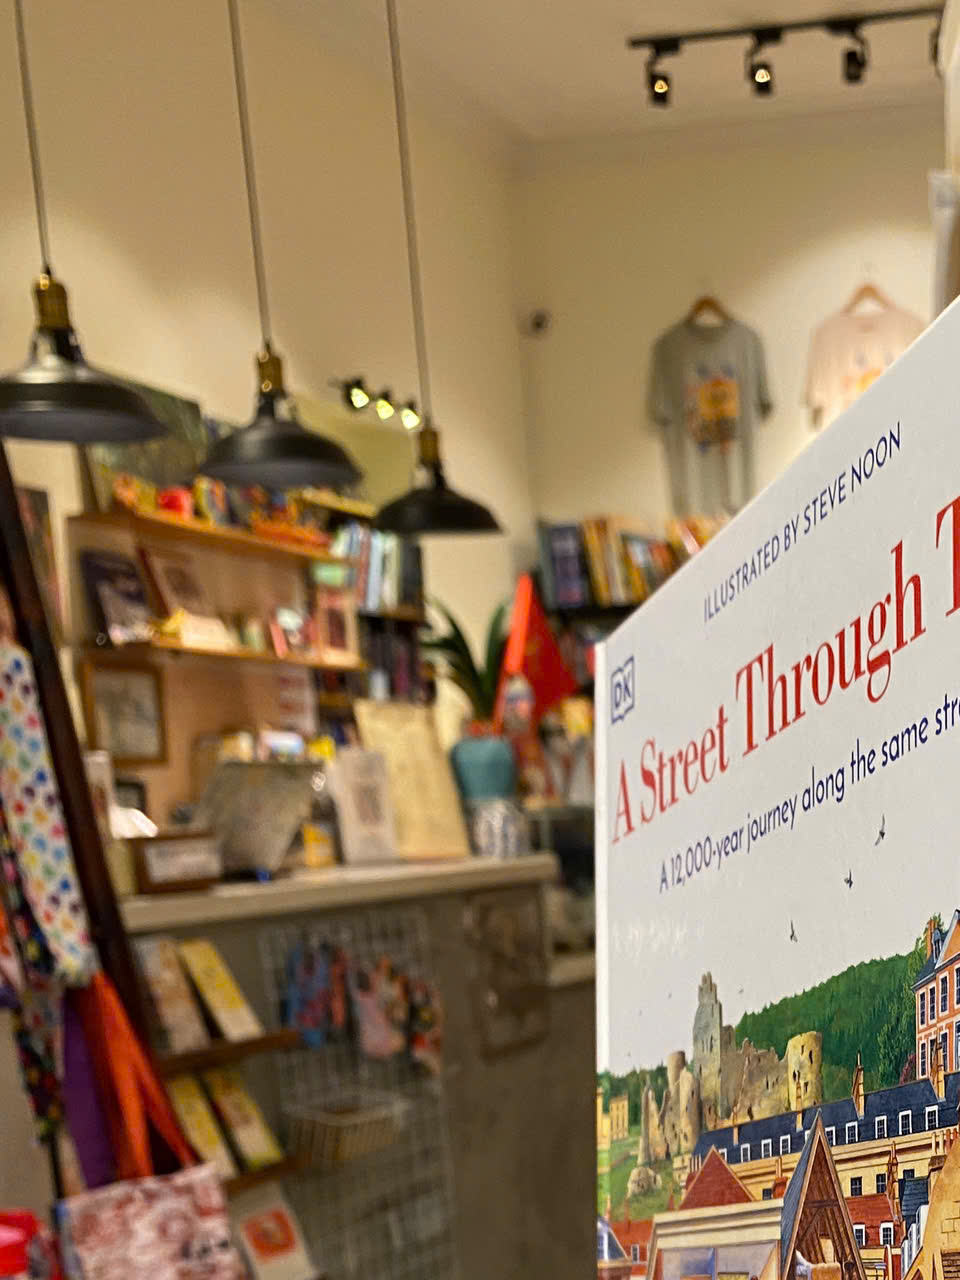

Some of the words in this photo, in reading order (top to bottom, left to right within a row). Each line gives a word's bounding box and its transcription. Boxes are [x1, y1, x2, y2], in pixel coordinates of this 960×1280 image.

[704, 536, 779, 623] ILLUSTRATED
[784, 514, 800, 551] BY
[804, 471, 846, 535] STEVE
[852, 421, 900, 493] NOON
[612, 758, 635, 845] A
[640, 703, 730, 824] Street
[735, 539, 926, 758] Through
[659, 861, 670, 894] A
[671, 826, 744, 887] 12,000-year
[747, 795, 798, 854] journey
[802, 766, 845, 812] along
[850, 738, 877, 785] the
[882, 717, 929, 767] same
